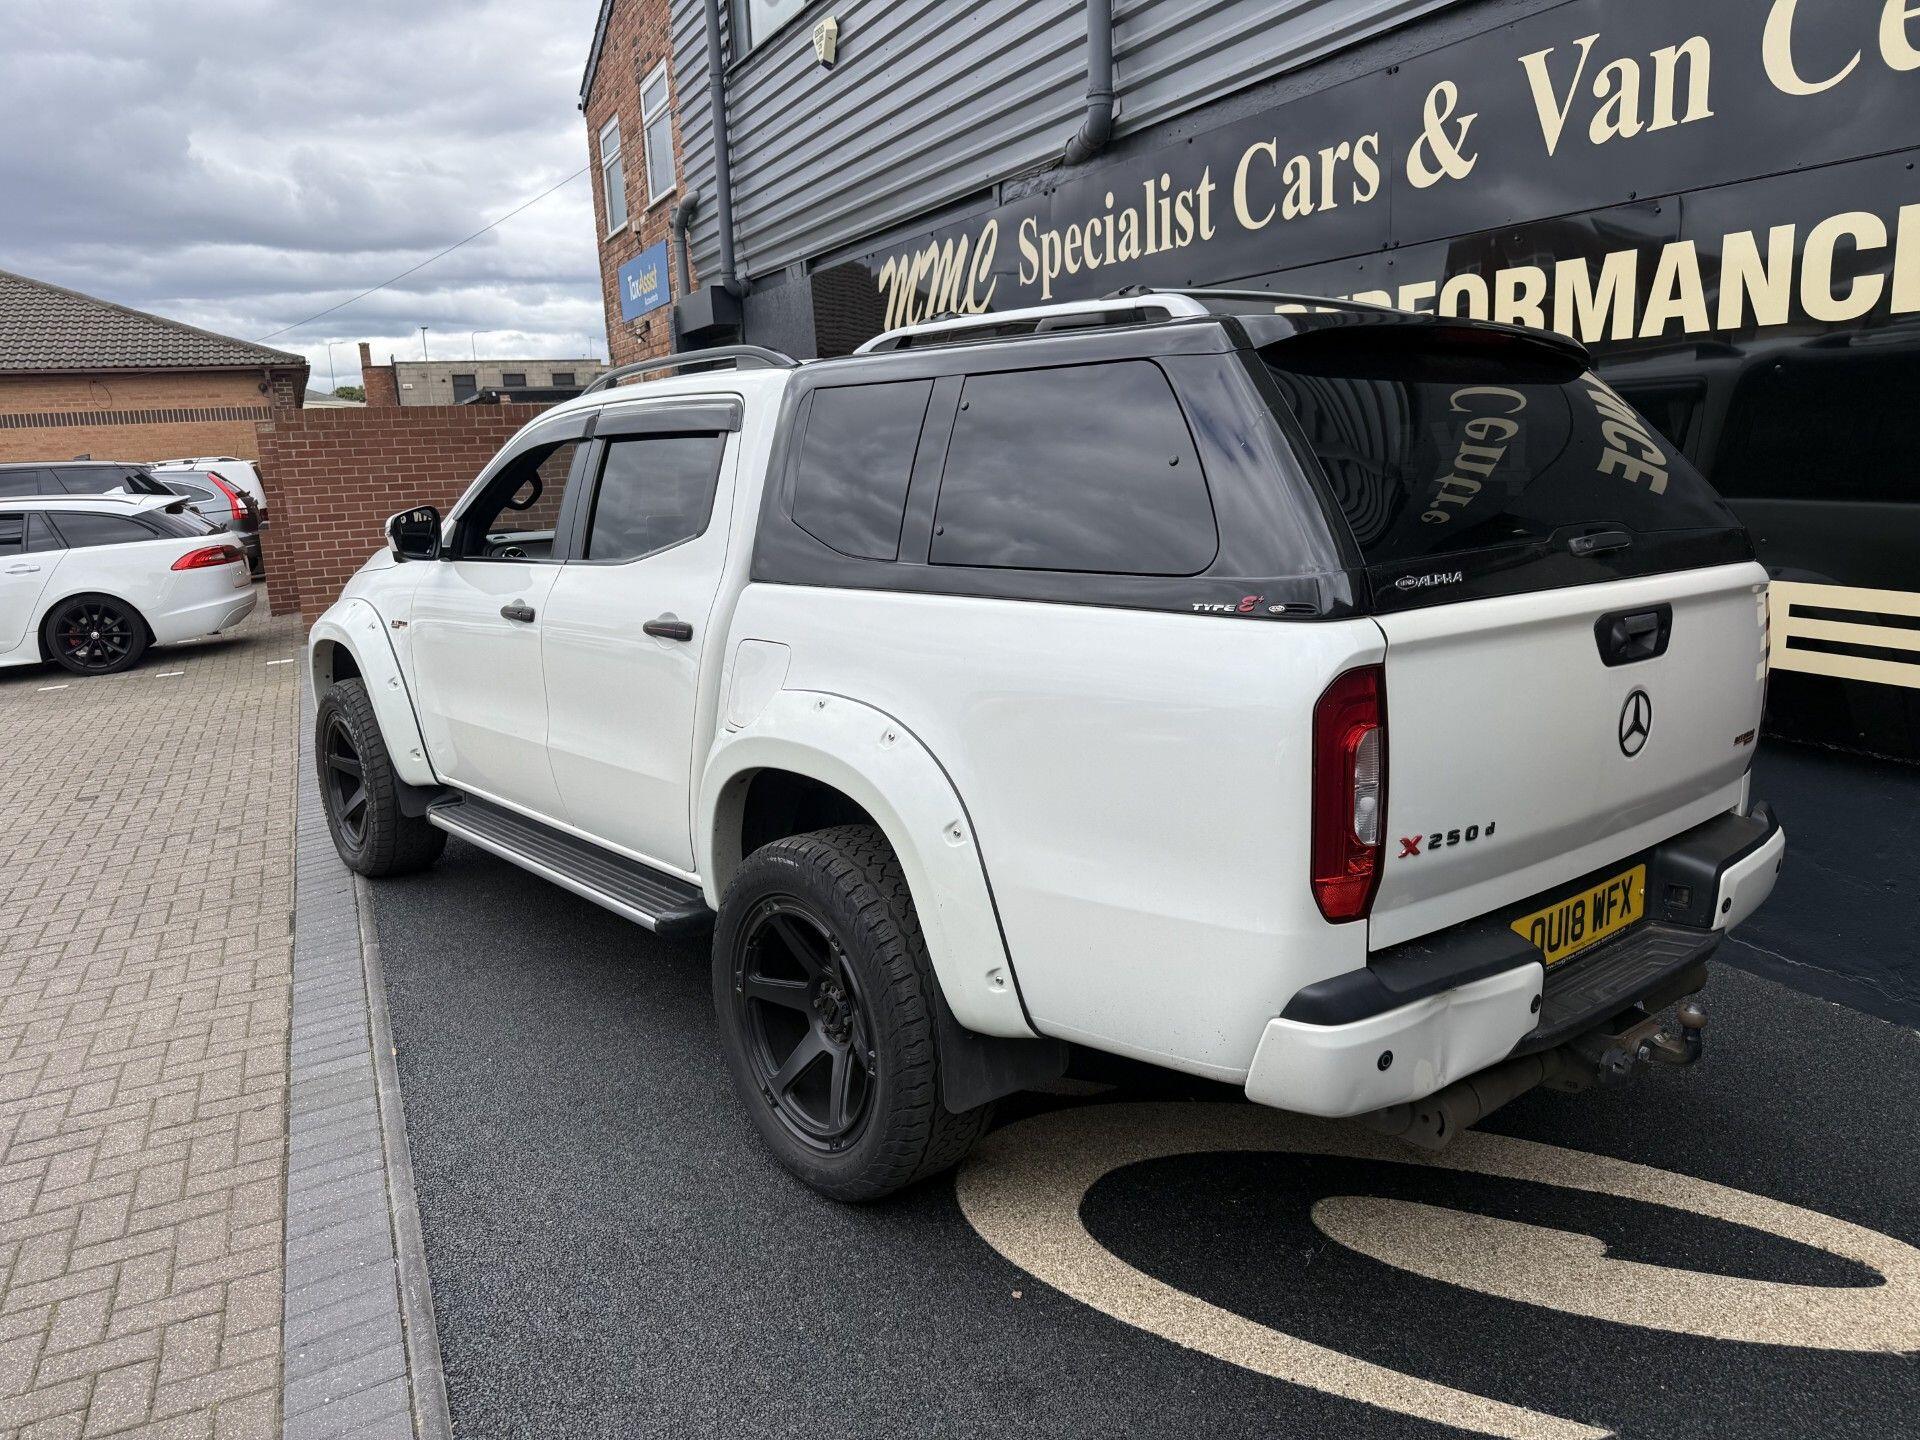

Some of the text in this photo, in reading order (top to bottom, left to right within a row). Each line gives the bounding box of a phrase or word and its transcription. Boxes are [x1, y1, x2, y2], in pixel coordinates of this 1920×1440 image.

[1018, 165, 1216, 300] Specialist
[1233, 131, 1380, 231] Cars
[1405, 80, 1479, 189] &
[1517, 33, 1715, 158] Van
[1417, 570, 1463, 588] ALPHA
[1192, 602, 1238, 613] TYPE
[1592, 874, 1634, 934] WFX
